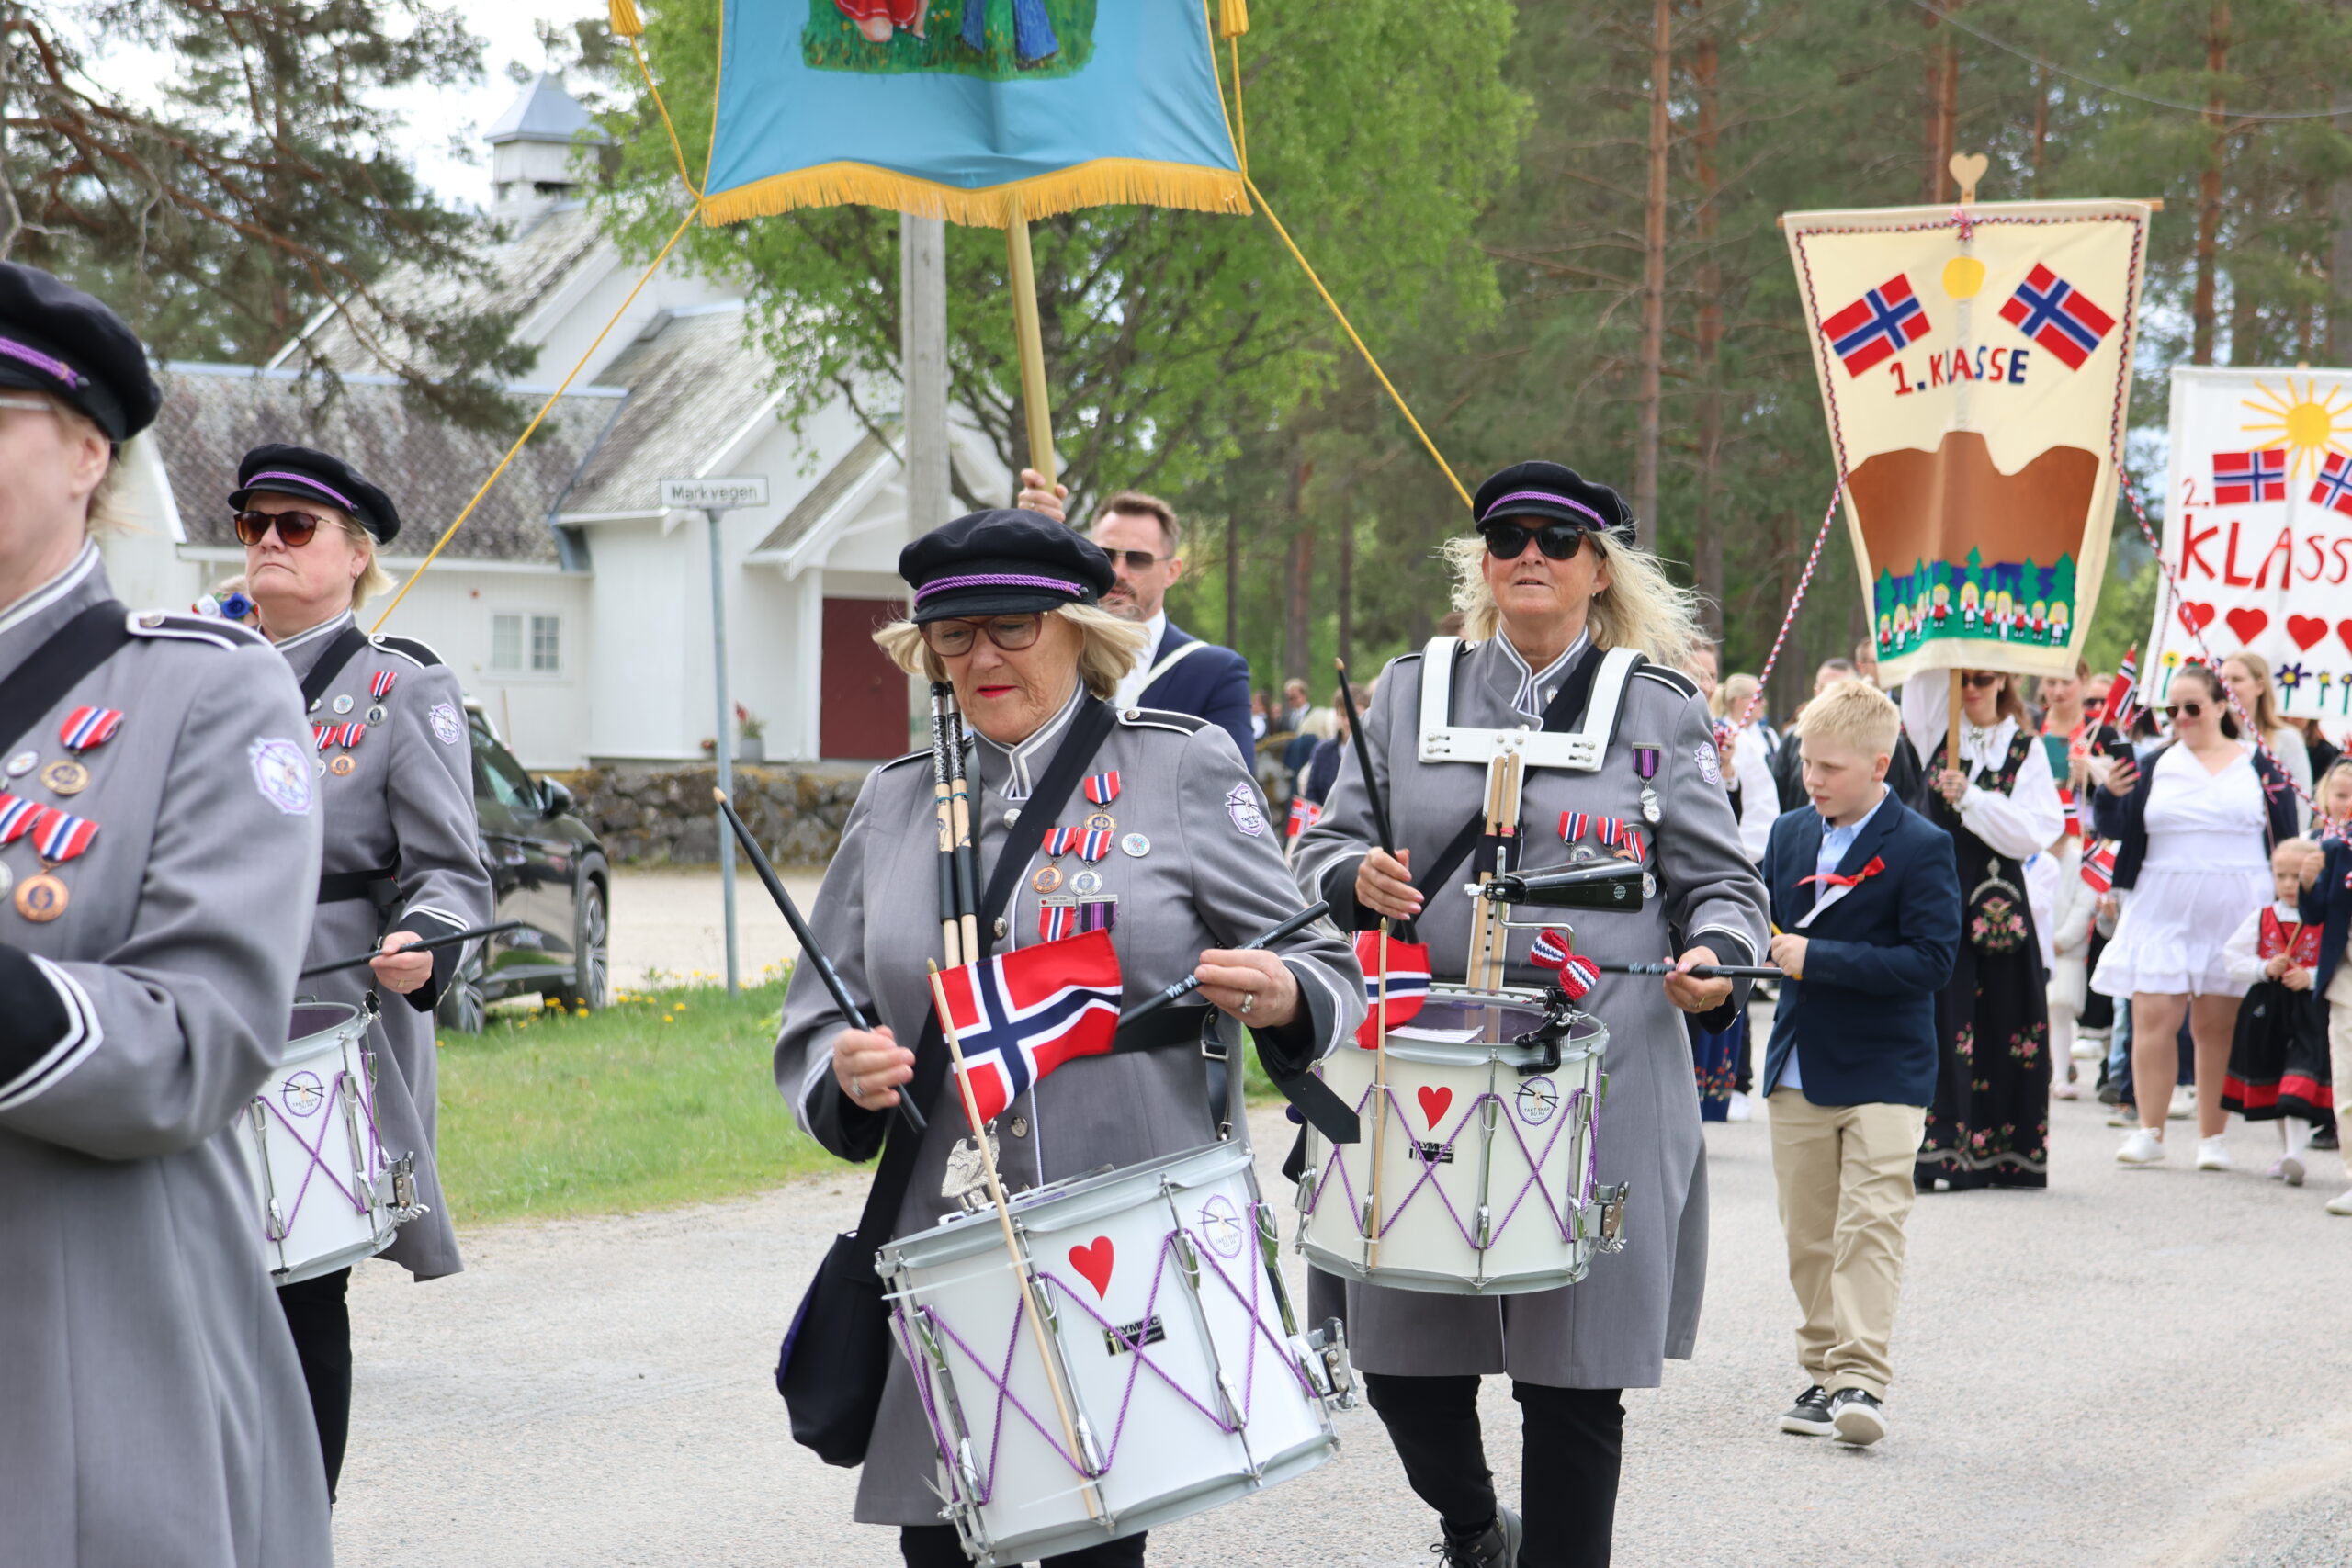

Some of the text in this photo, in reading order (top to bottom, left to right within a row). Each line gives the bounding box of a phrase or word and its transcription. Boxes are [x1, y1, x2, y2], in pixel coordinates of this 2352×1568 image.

[1889, 345, 2030, 396] 1. KLASSE
[672, 485, 757, 502] Markvegen
[2182, 478, 2210, 506] 2.
[1411, 1140, 1453, 1151] LYMPC
[1106, 1315, 1159, 1338] OYMC
